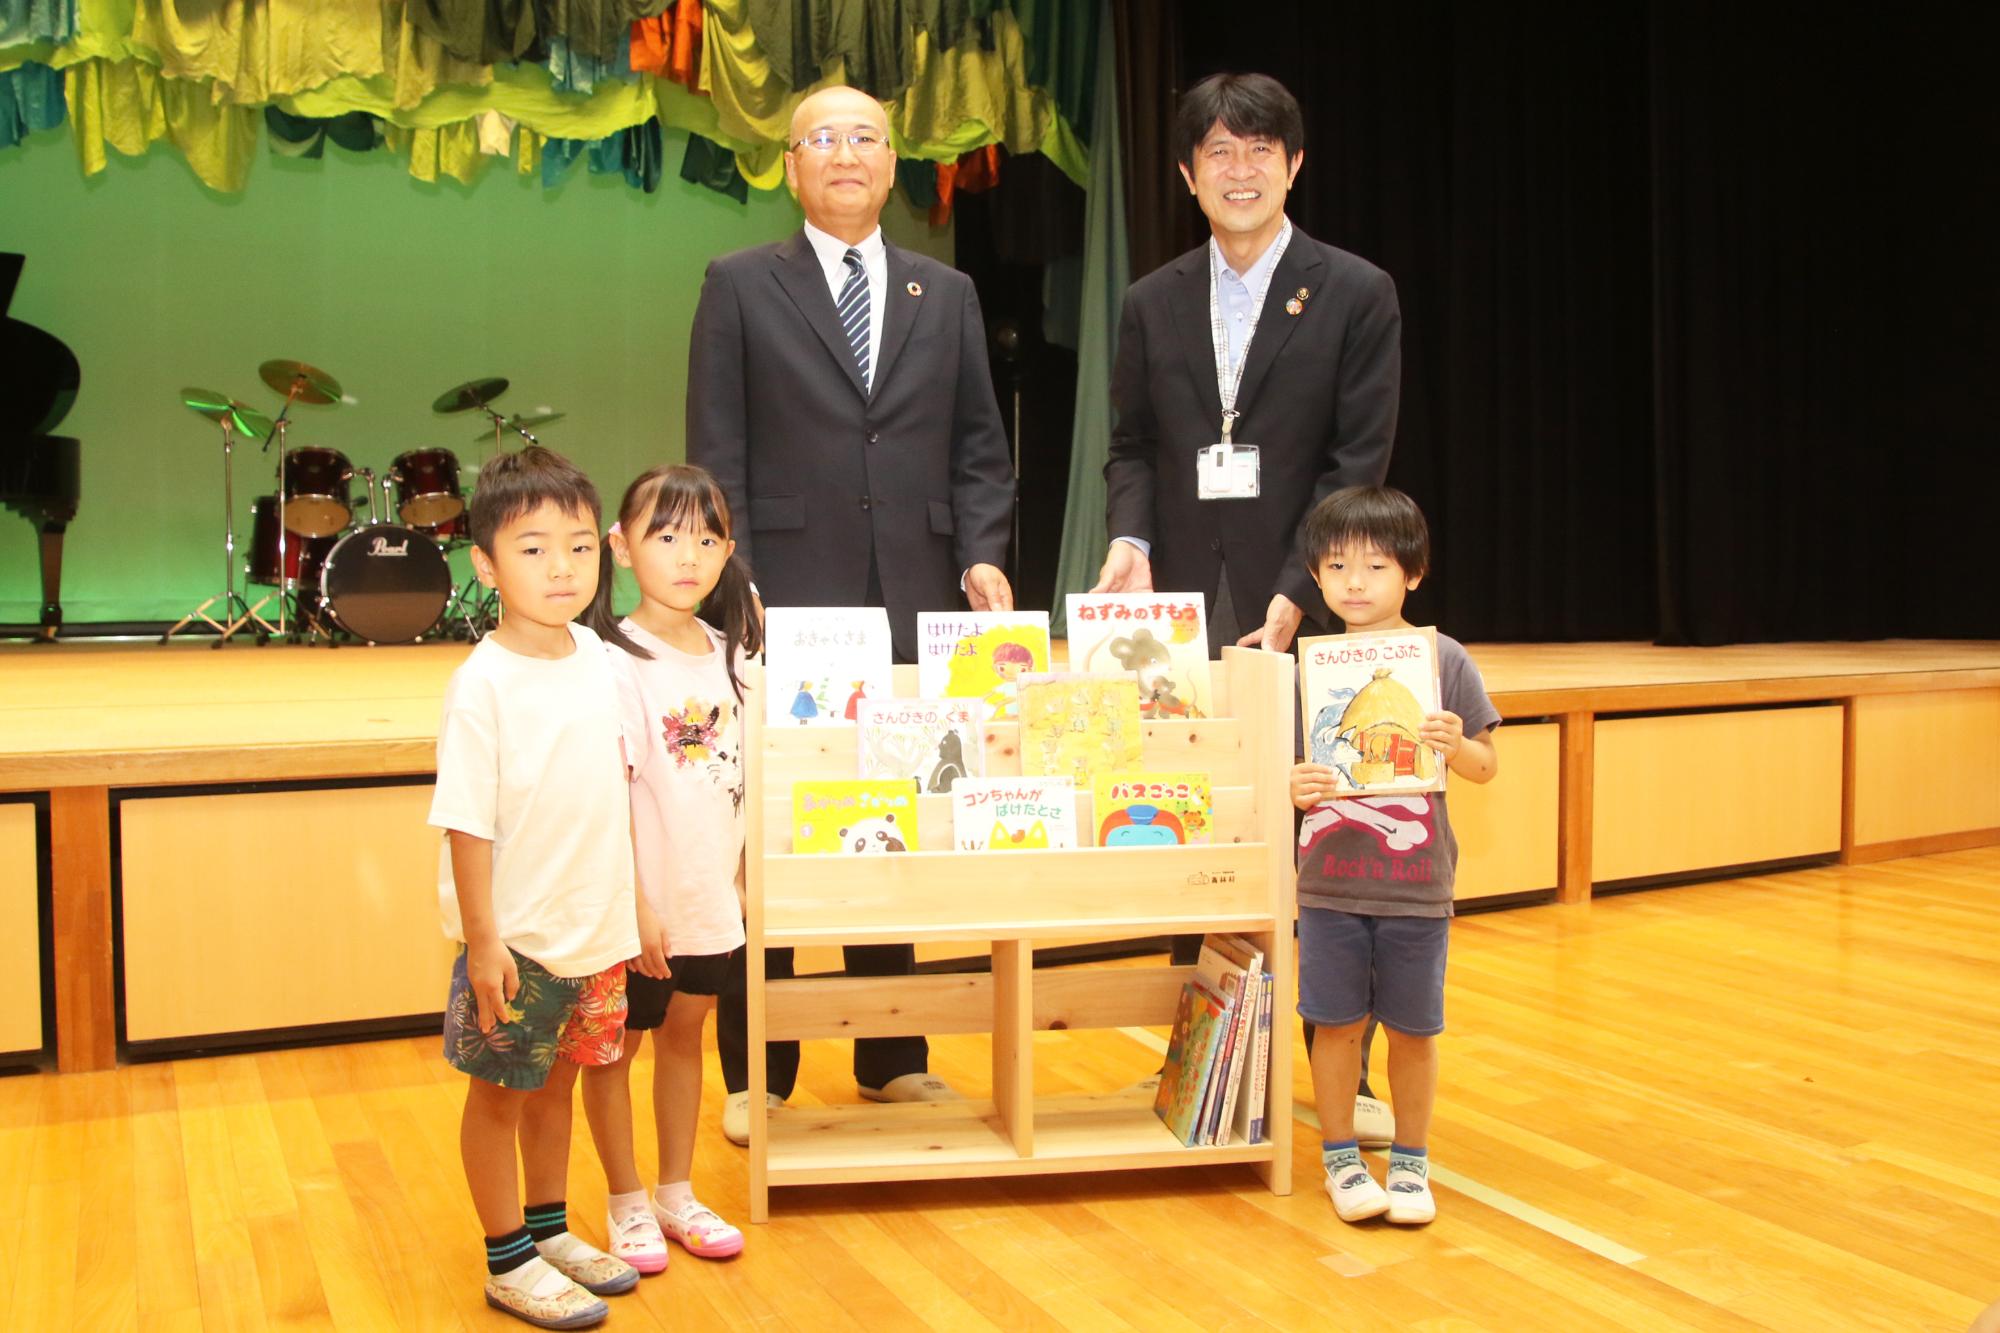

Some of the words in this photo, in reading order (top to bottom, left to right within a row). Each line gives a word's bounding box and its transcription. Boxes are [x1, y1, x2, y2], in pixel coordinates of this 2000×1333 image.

[367, 536, 409, 557] Pearl
[1077, 602, 1201, 621] ねずみのすもう
[793, 628, 867, 647] おきゃくさま
[927, 622, 984, 638] はけたよ
[928, 642, 978, 656] はけたよ
[1383, 643, 1421, 661] こぶた
[945, 710, 970, 724] くま
[962, 787, 1044, 807] コンちゃんが
[1111, 782, 1190, 800] バスごっこ
[1390, 857, 1433, 881] Roll
